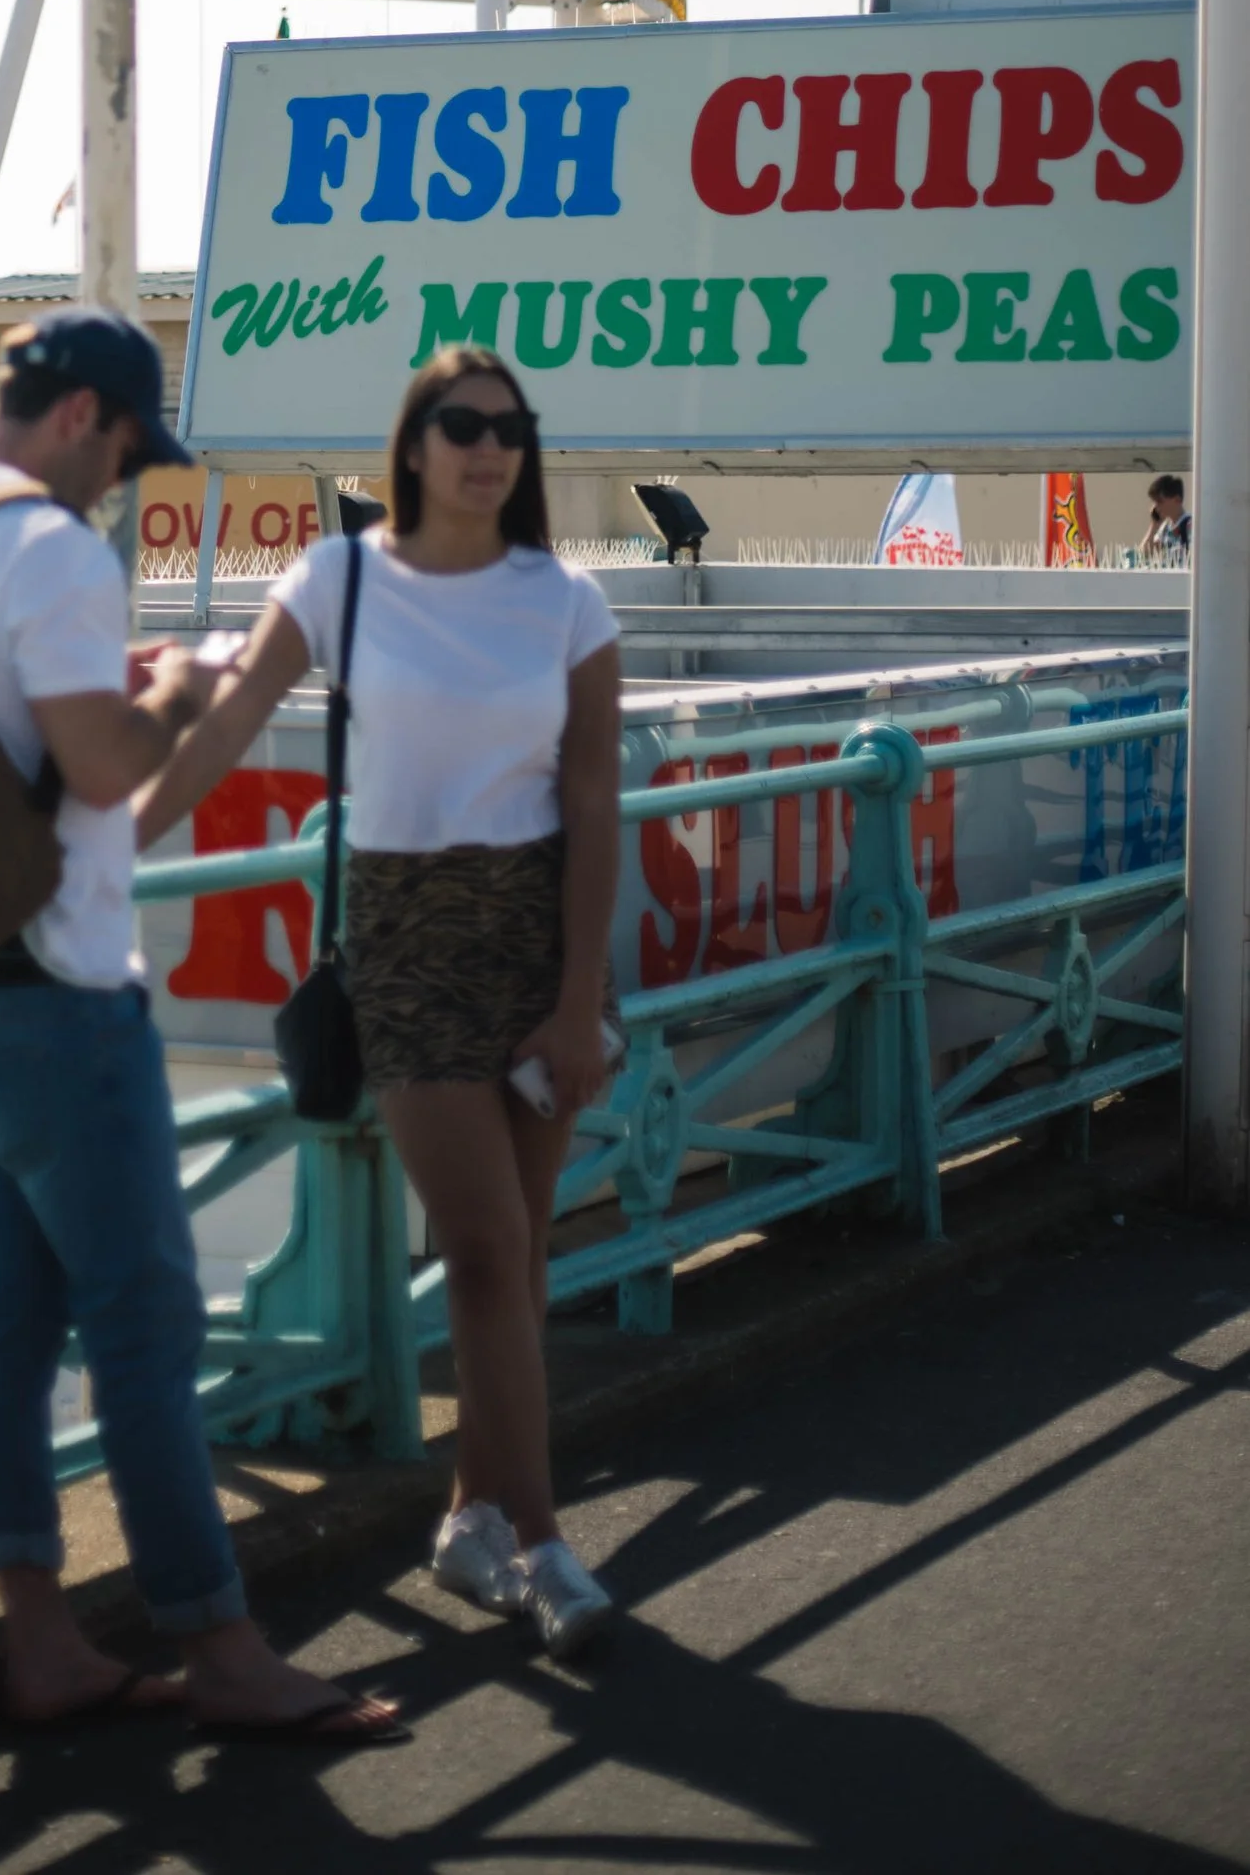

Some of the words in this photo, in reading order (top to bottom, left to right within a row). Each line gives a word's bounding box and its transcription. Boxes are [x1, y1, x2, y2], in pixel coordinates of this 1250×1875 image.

[272, 86, 629, 224] FISH
[690, 58, 1183, 215] CHIPS
[212, 255, 389, 356] With
[409, 276, 828, 369] MUSHY
[882, 266, 1180, 364] PEAS
[638, 723, 961, 989] SLUH
